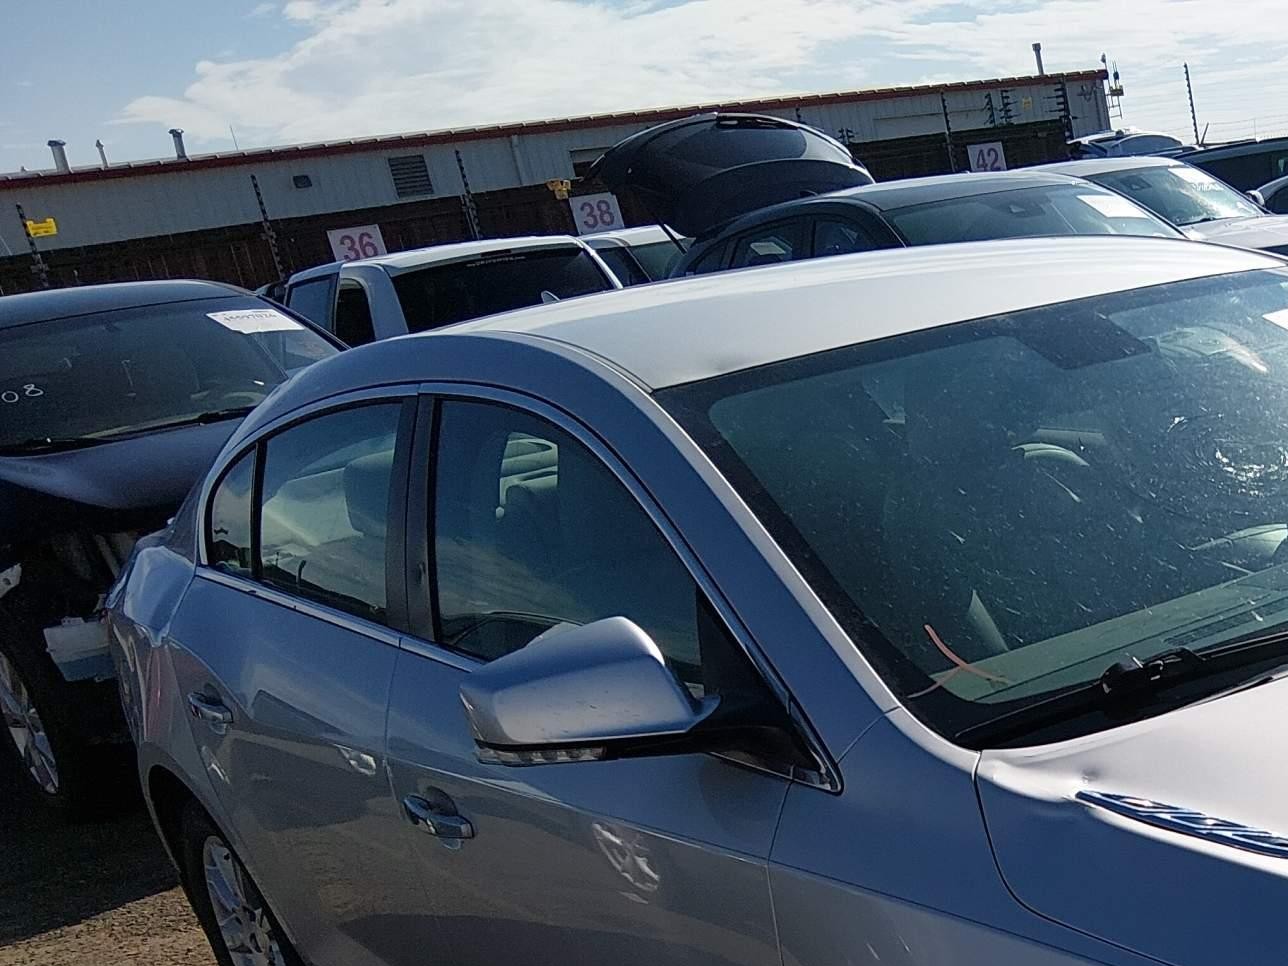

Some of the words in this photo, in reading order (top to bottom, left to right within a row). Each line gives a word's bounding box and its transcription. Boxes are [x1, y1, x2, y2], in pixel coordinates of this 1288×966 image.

[976, 147, 1001, 171] 42
[580, 199, 614, 229] 38
[340, 232, 378, 262] 36
